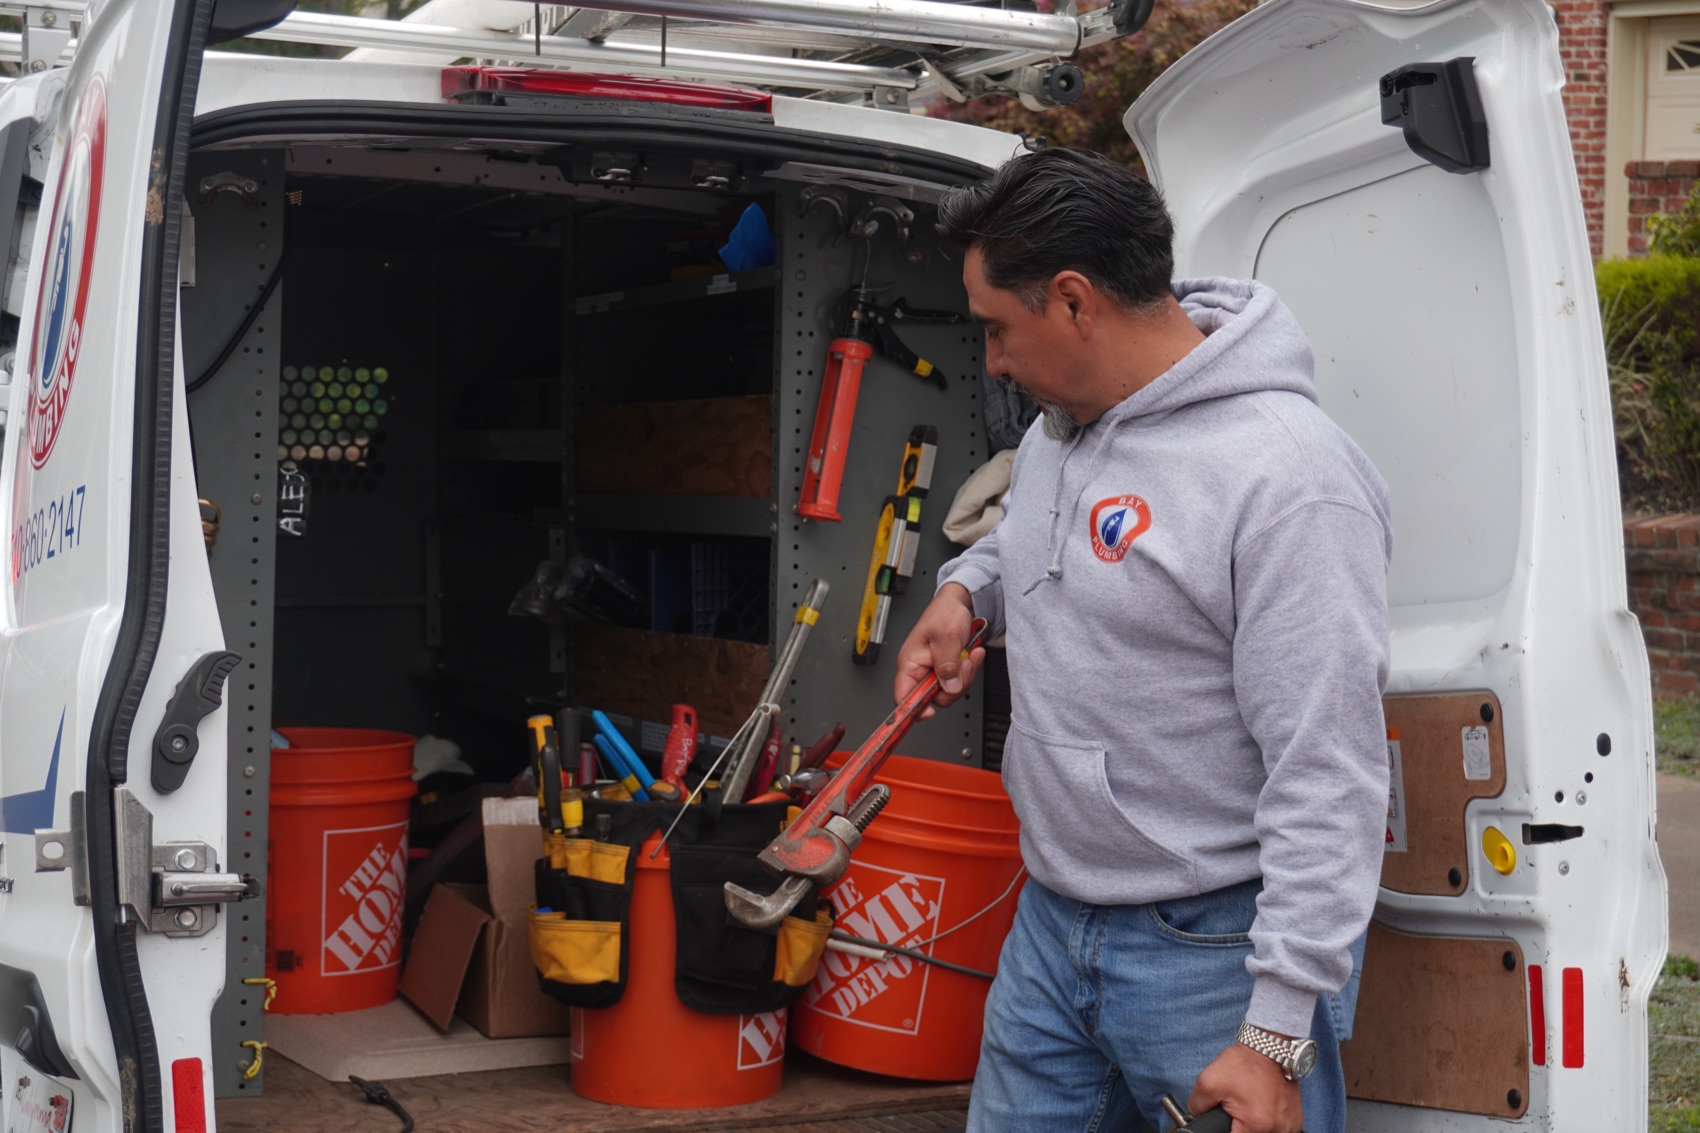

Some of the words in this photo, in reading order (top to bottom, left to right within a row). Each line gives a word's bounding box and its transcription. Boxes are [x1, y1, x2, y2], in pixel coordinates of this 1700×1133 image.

[1118, 497, 1142, 509] BAY
[1093, 536, 1128, 560] PLUMBING
[339, 842, 391, 902] THE
[325, 834, 408, 971] HOM
[826, 877, 864, 920] HE
